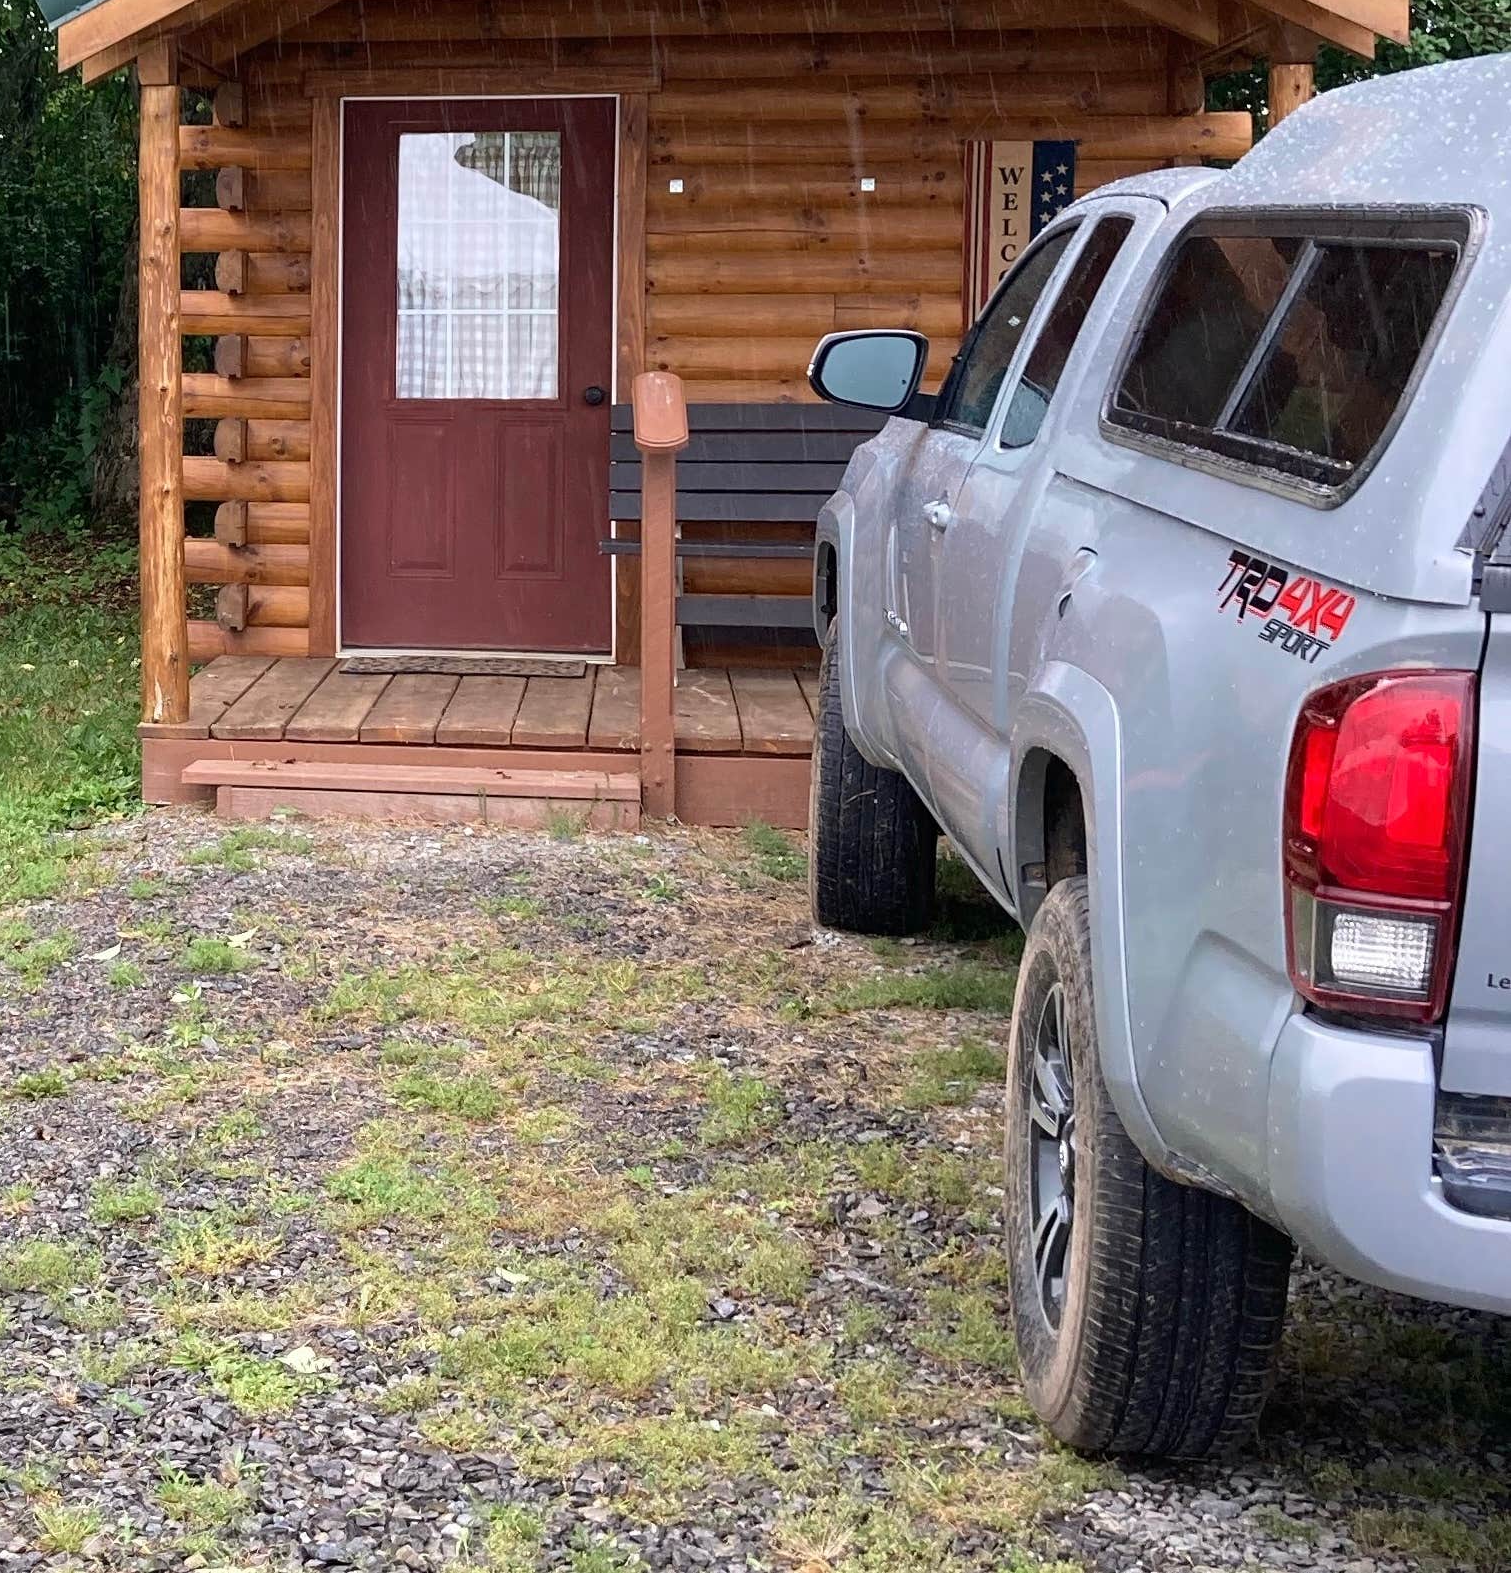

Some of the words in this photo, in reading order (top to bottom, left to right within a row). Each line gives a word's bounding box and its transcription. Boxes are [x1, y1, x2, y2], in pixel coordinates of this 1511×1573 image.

[998, 167, 1025, 281] WELC
[1217, 549, 1289, 622] TRD
[1258, 618, 1331, 664] SPORT
